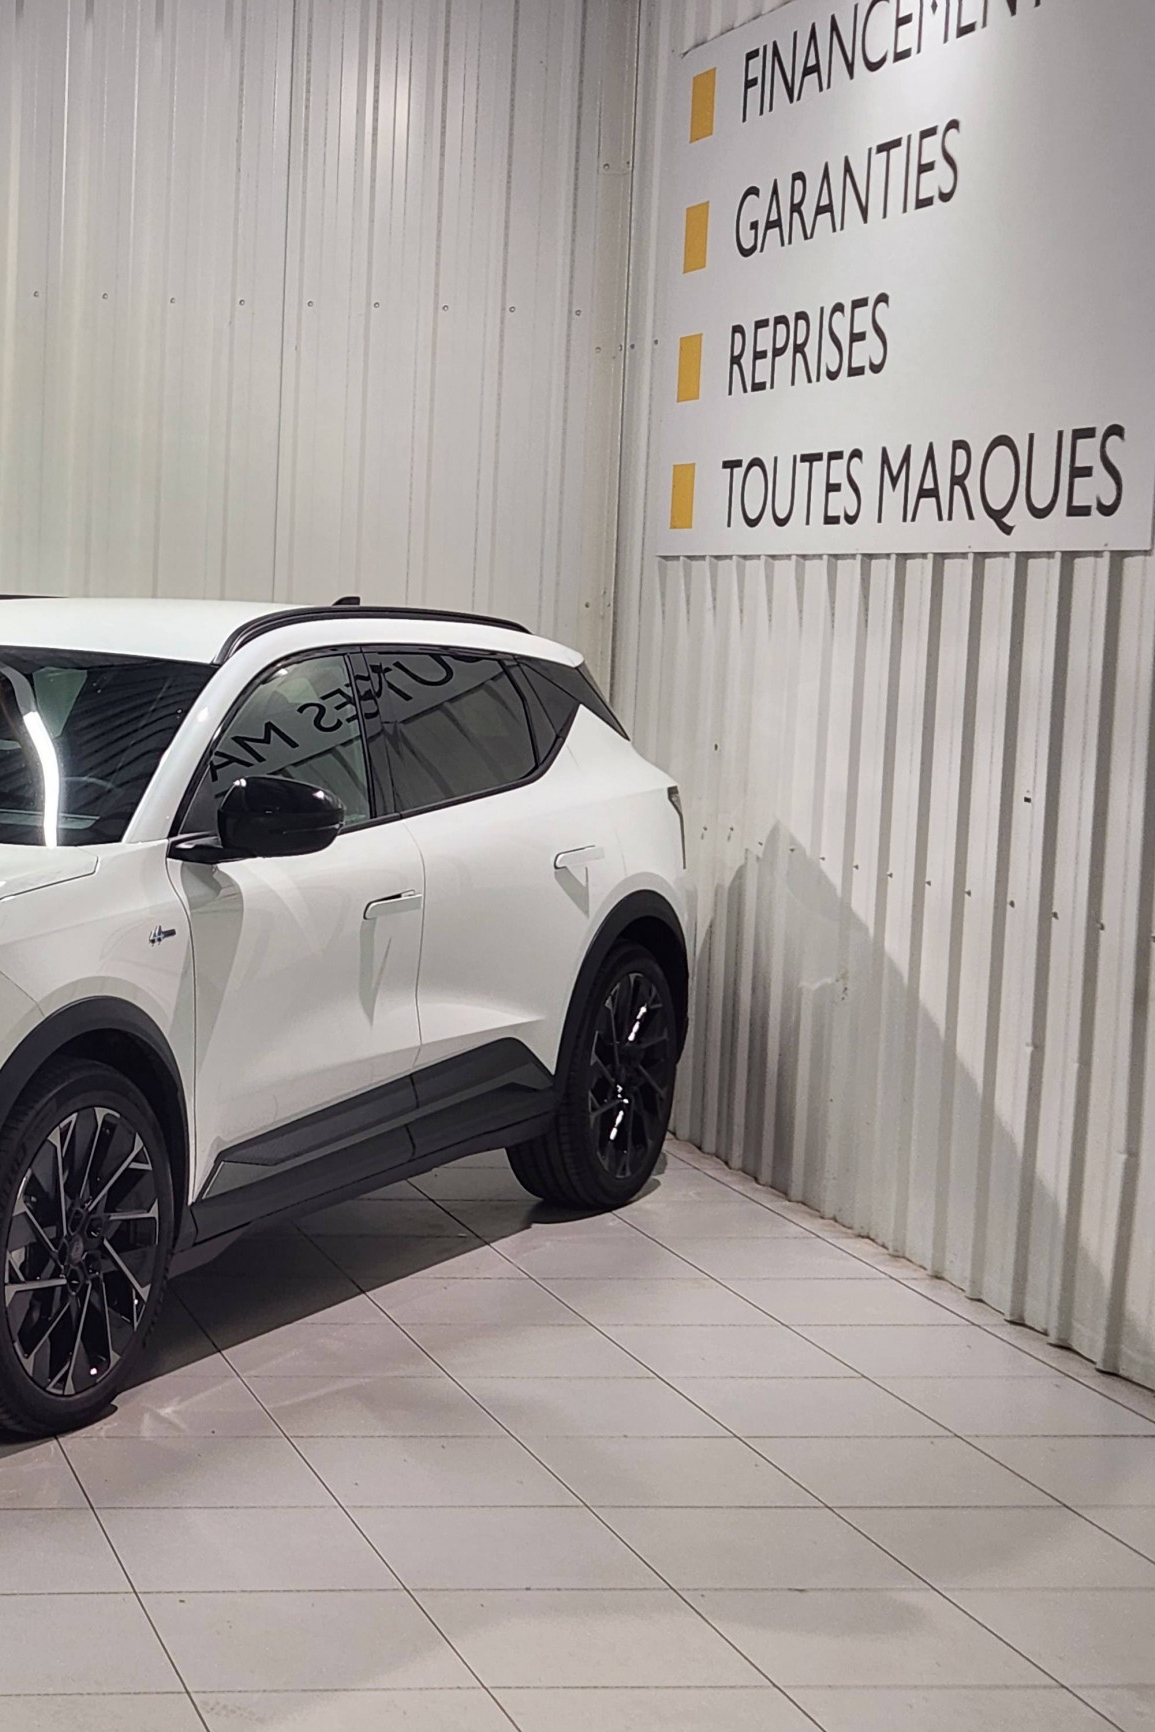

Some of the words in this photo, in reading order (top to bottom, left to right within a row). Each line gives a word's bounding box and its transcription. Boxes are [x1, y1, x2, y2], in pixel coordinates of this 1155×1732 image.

[742, 0, 1041, 123] FINANCEM
[735, 119, 960, 257] GARANTIES
[728, 293, 889, 396] REPRISES
[722, 448, 863, 528] TOUTES
[877, 424, 1125, 536] MARQUES
